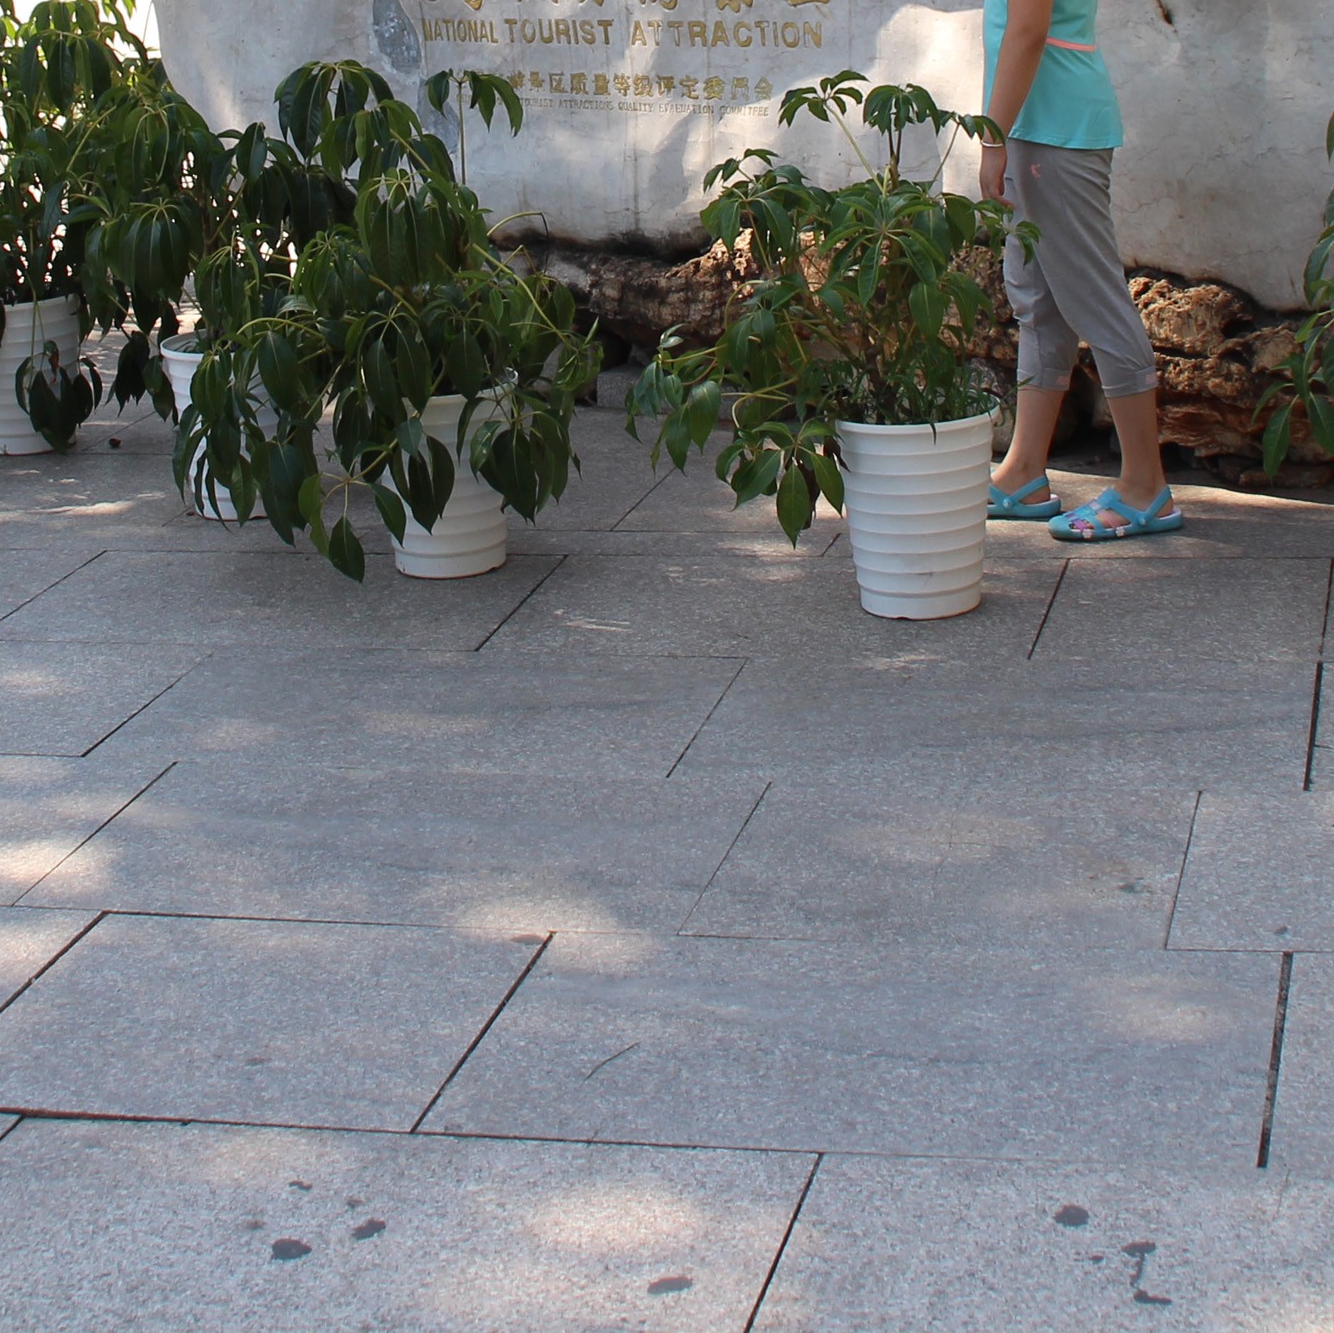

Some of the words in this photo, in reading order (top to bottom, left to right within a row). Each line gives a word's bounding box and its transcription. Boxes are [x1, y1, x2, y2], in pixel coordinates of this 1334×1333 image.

[422, 17, 499, 44] NATIONAL
[505, 18, 615, 47] TOURIST
[630, 19, 824, 49] ATTRACTION
[618, 100, 654, 113] QUALITY
